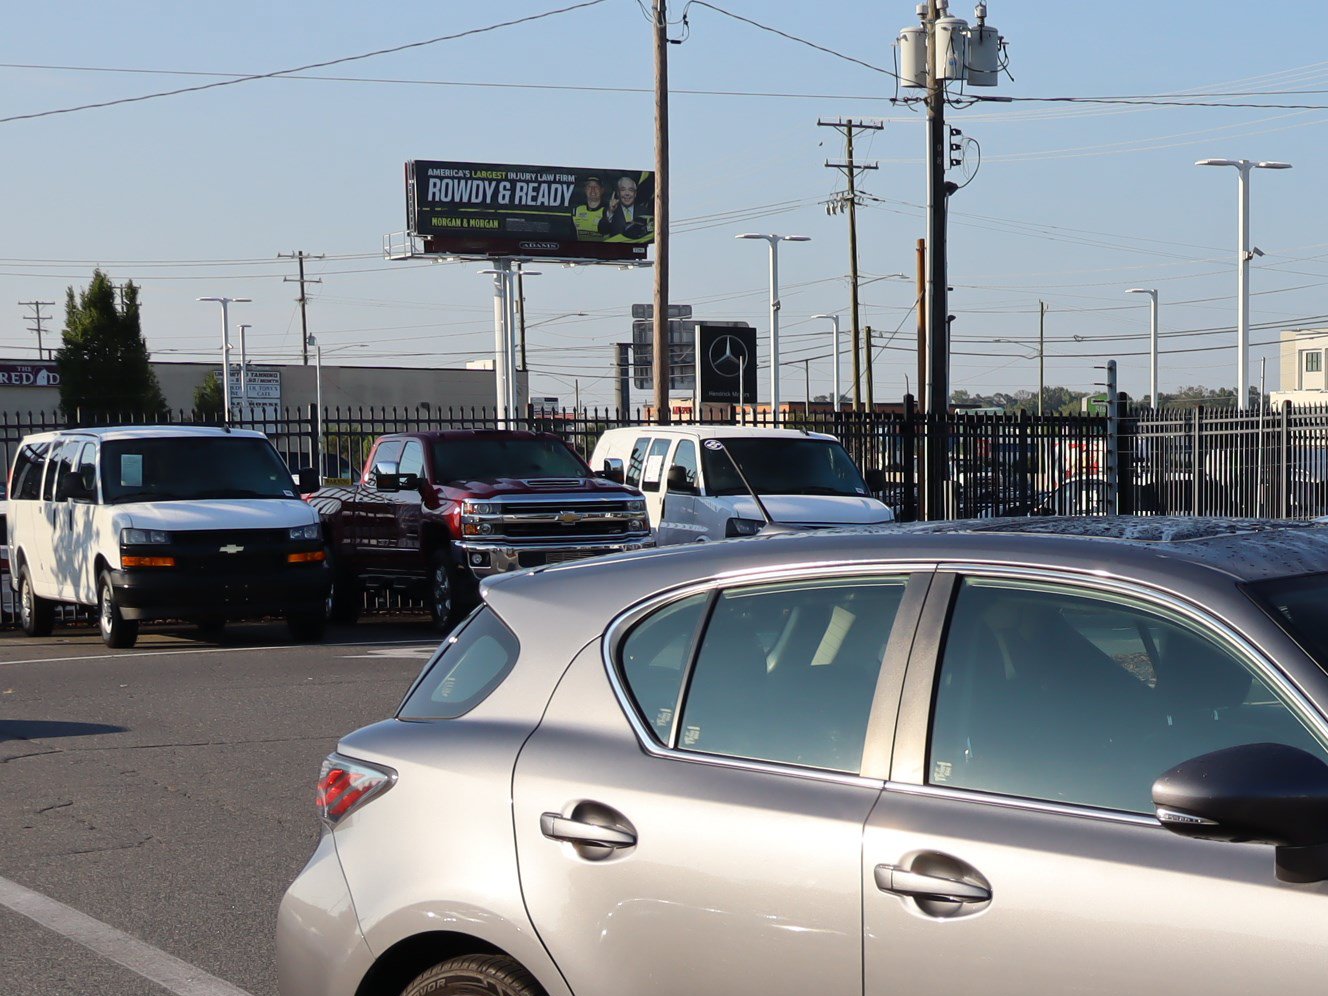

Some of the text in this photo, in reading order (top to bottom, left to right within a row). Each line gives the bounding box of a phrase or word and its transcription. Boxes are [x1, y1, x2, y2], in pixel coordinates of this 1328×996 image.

[427, 168, 575, 182] AMERICA'S LARGEST INJURY LAW FIRM
[427, 178, 575, 207] ROWDY & READY
[431, 217, 462, 228] MORGAN
[462, 218, 468, 227] &
[469, 218, 499, 229] MORGAN
